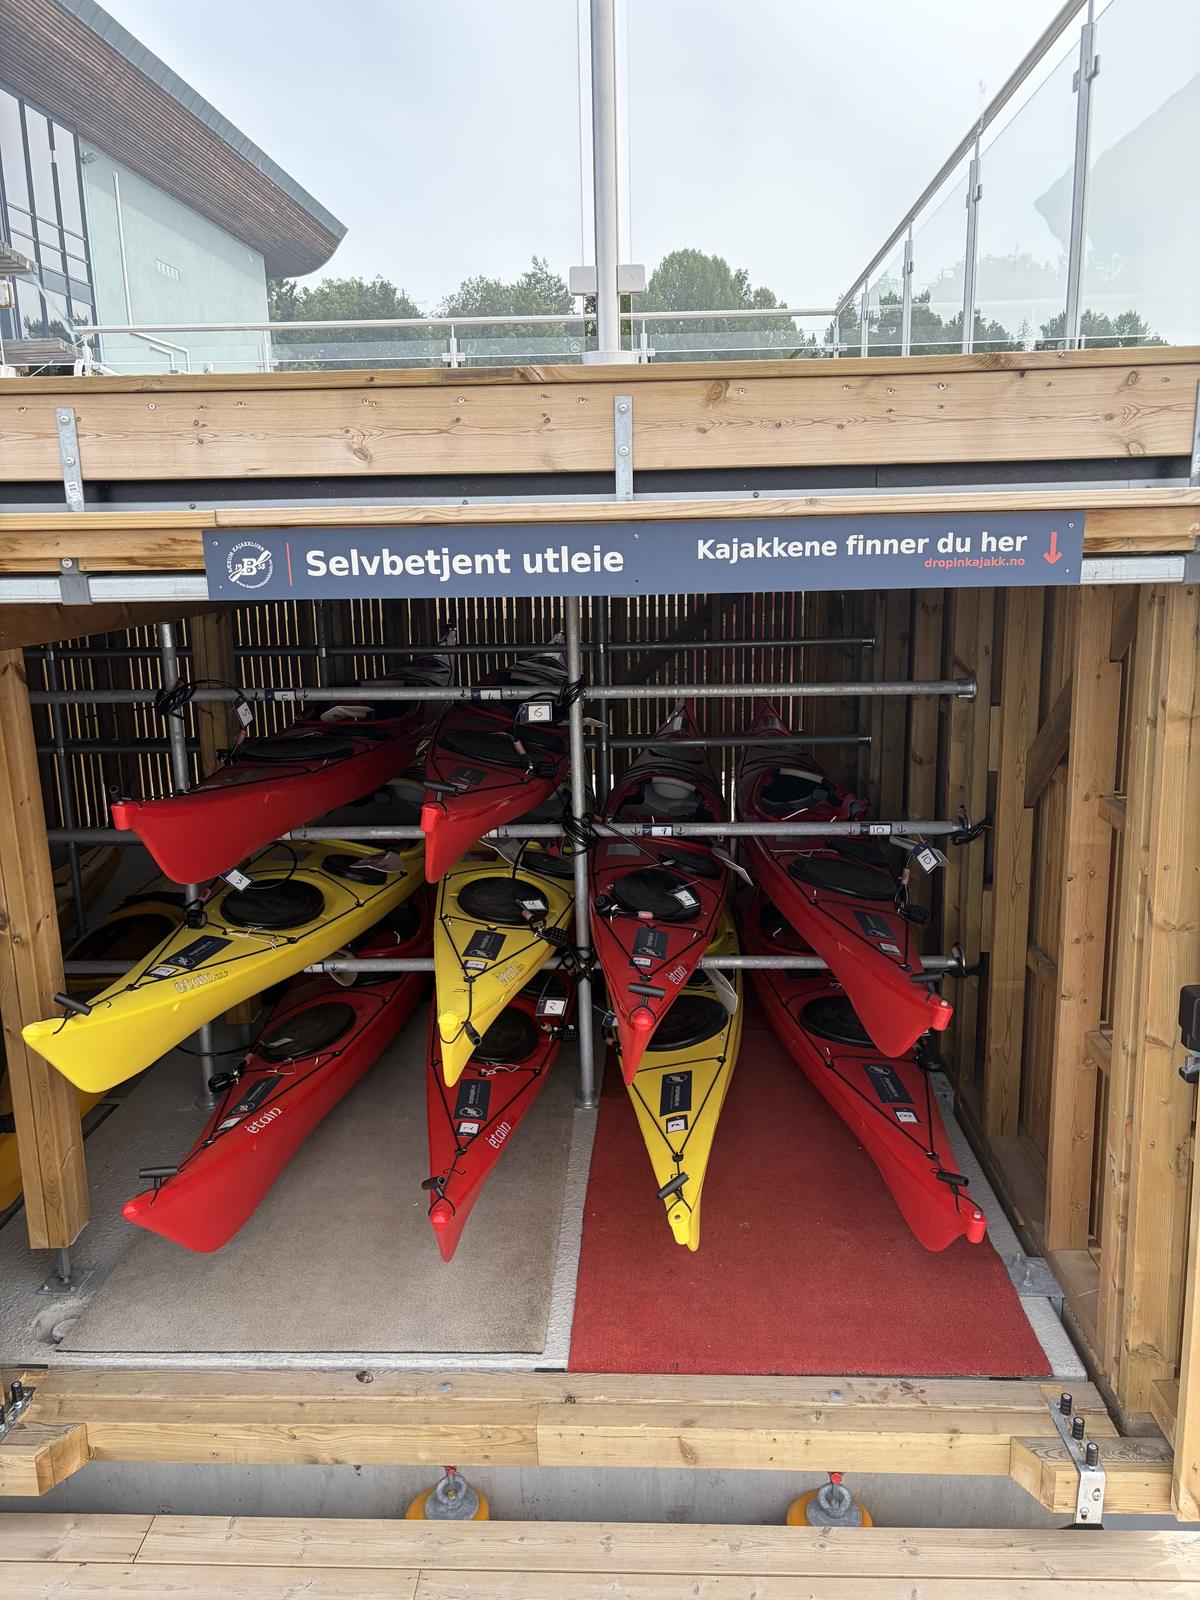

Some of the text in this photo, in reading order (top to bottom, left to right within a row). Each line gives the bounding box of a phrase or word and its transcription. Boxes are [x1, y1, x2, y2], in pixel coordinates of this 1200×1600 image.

[697, 531, 1028, 564] Kajakkene finner du her
[306, 545, 624, 581] Selvbetjent utleie
[924, 557, 1026, 569] dropinkajakk.no
[533, 707, 544, 718] 6
